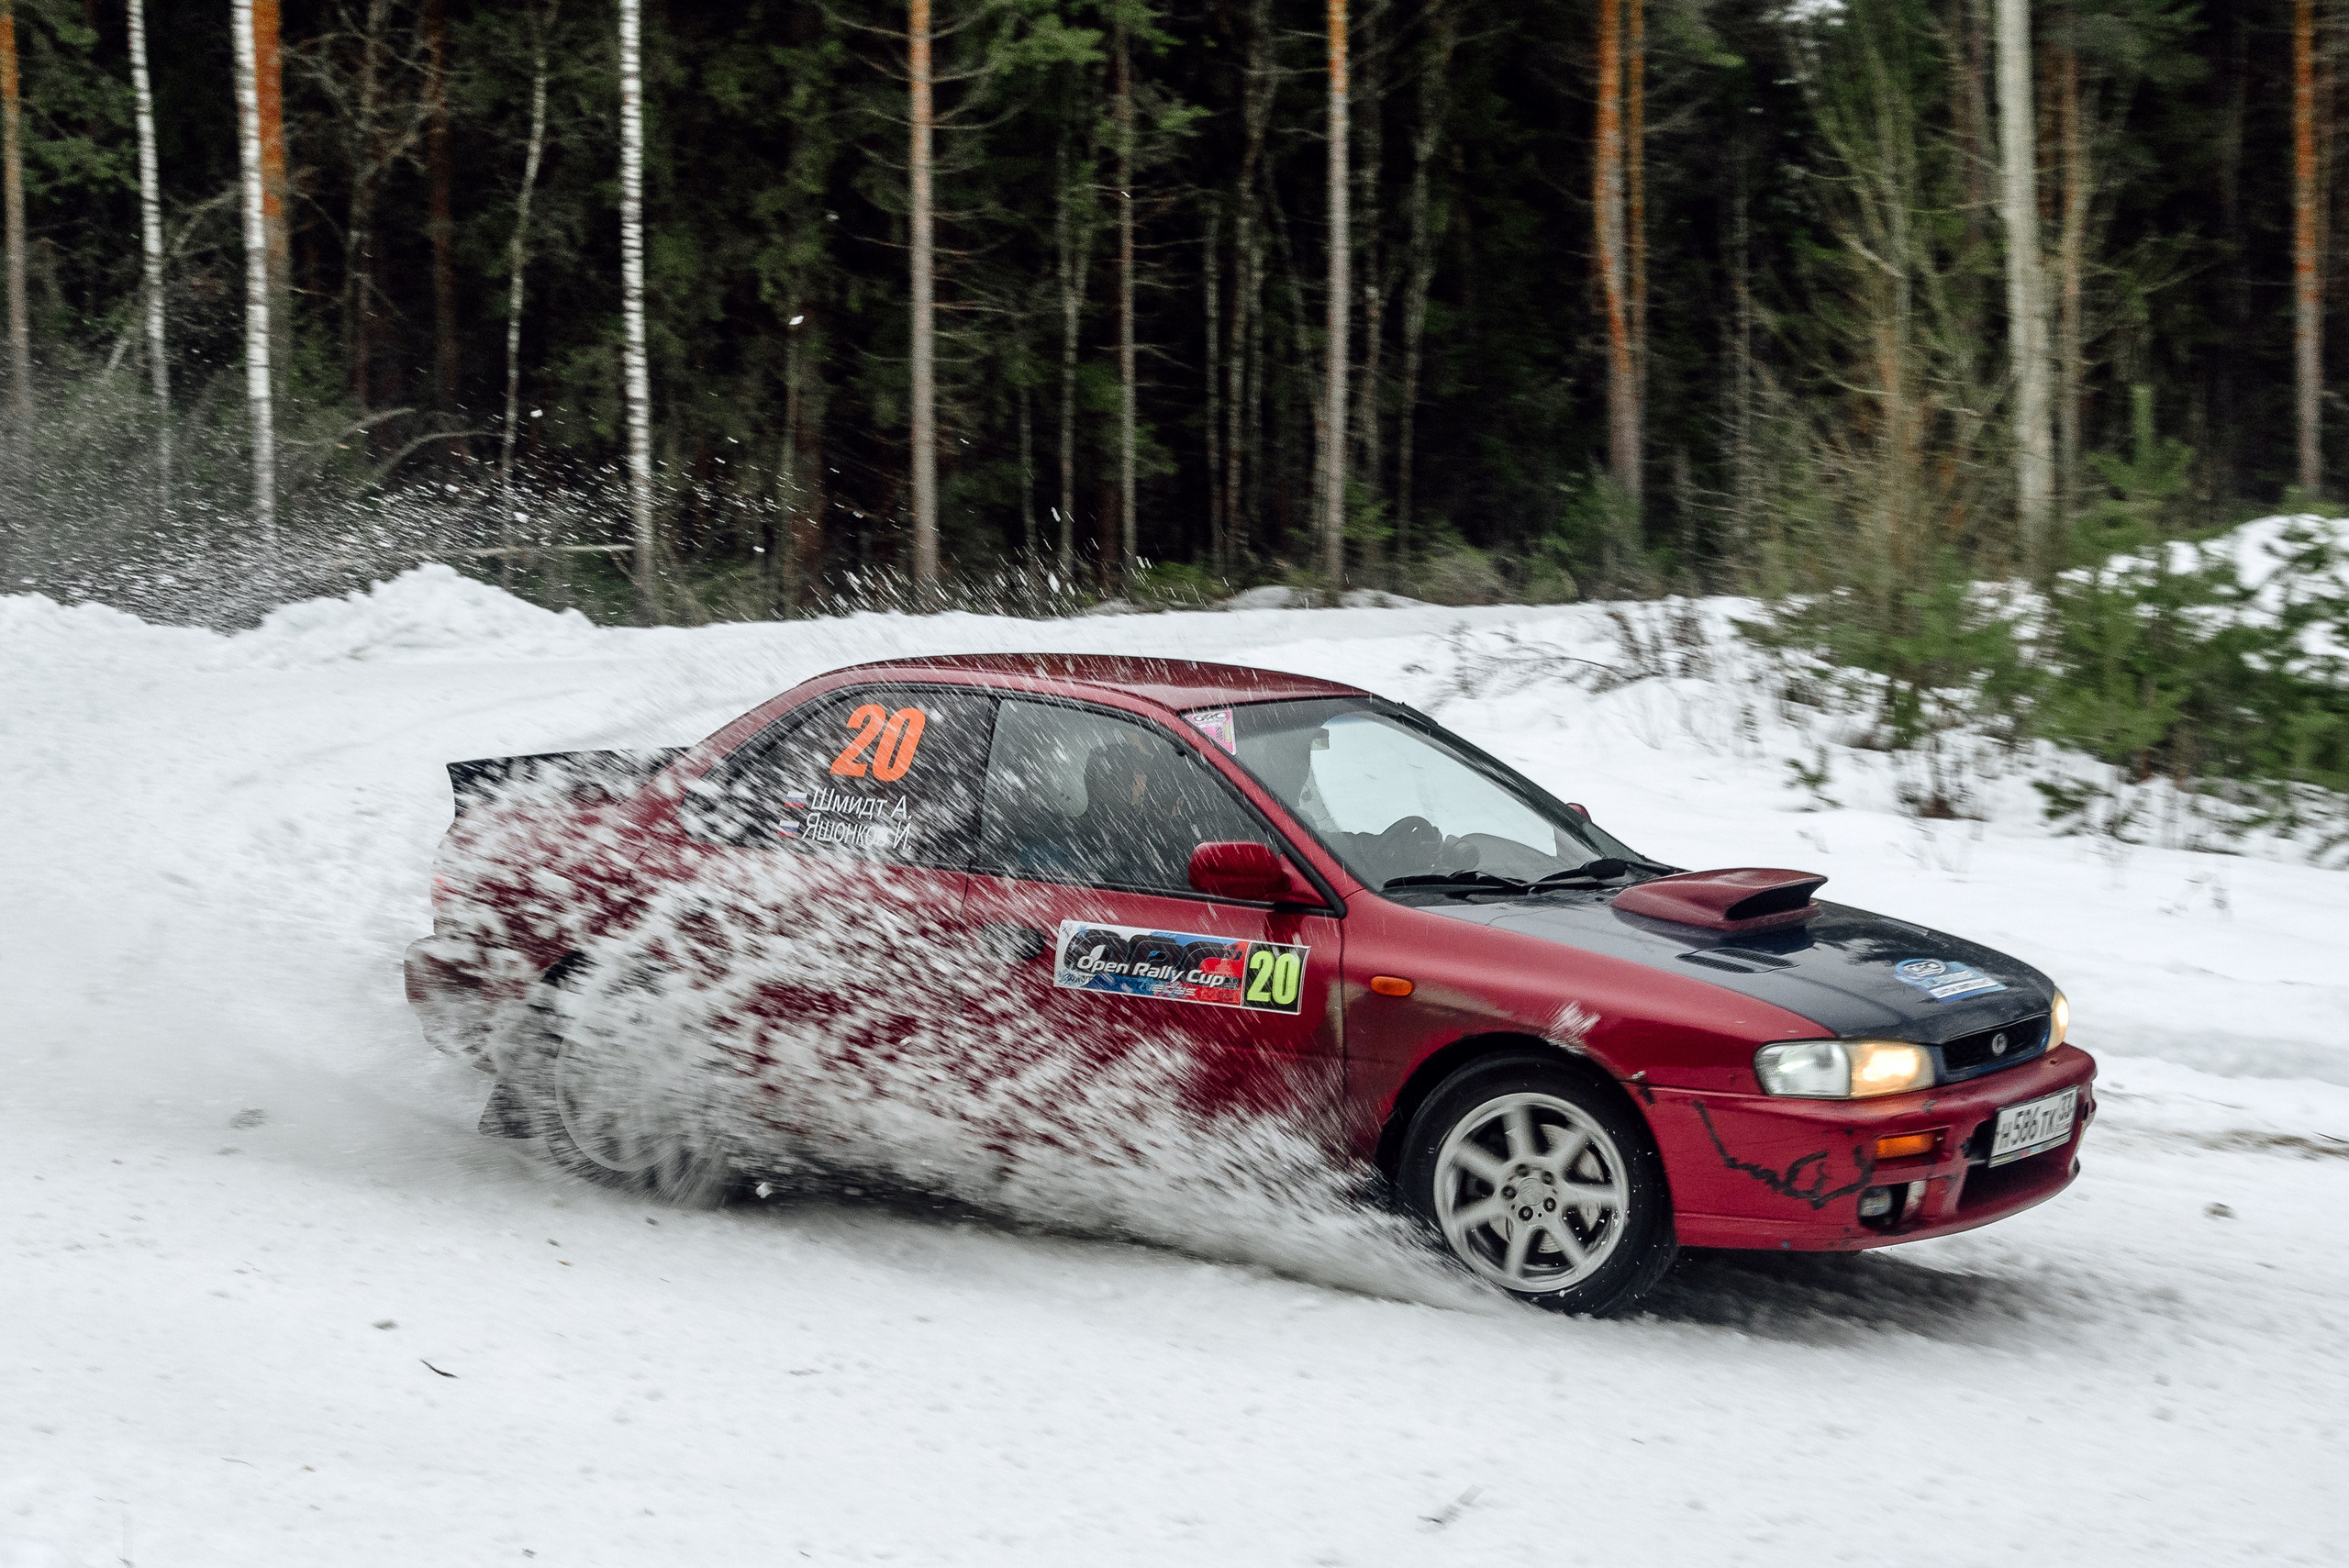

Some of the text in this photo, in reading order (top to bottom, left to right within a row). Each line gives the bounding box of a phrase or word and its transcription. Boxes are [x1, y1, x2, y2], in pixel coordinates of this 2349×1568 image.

[829, 704, 927, 783] 20
[810, 787, 912, 820] Шмидт А.
[892, 821, 912, 851] И.
[1076, 953, 1225, 988] Open Rally Cup
[1246, 950, 1300, 1006] 20
